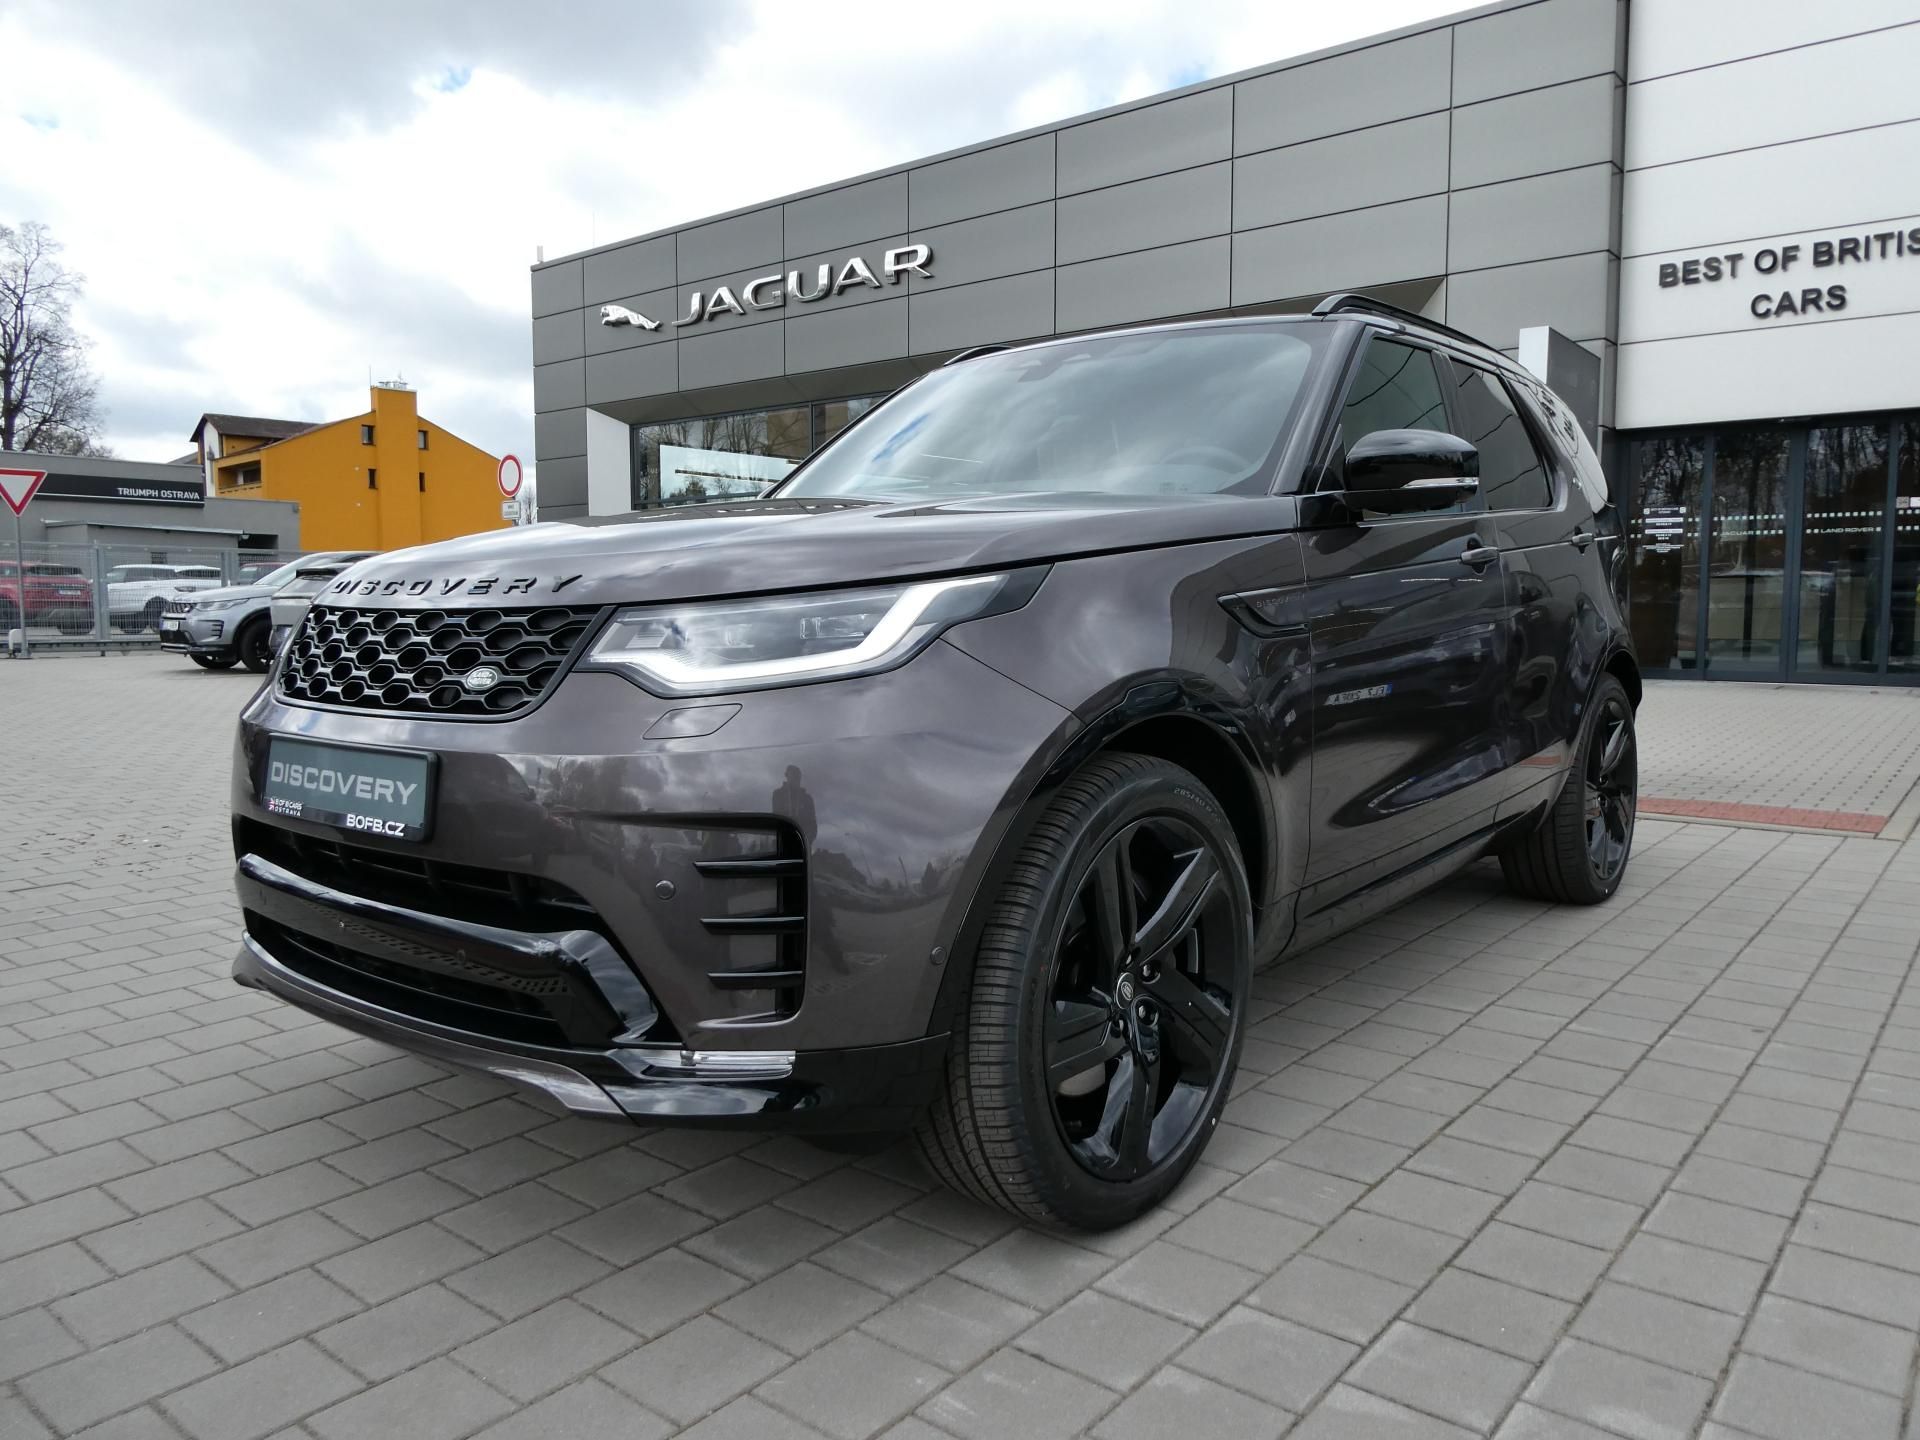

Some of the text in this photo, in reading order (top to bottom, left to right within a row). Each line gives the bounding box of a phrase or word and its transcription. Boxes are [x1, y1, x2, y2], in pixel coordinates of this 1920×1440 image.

[1658, 252, 1744, 288] BEST
[1754, 244, 1801, 275] OF
[671, 243, 934, 327] JAGUAR
[1750, 284, 1848, 319] CARS
[117, 487, 200, 500] TRIUMPH OSTRAVA
[330, 574, 583, 595] DISCOVERY
[271, 761, 418, 805] DISCOVERY
[274, 805, 301, 817] OSTRAVA
[346, 813, 406, 837] BOFB.CZ
